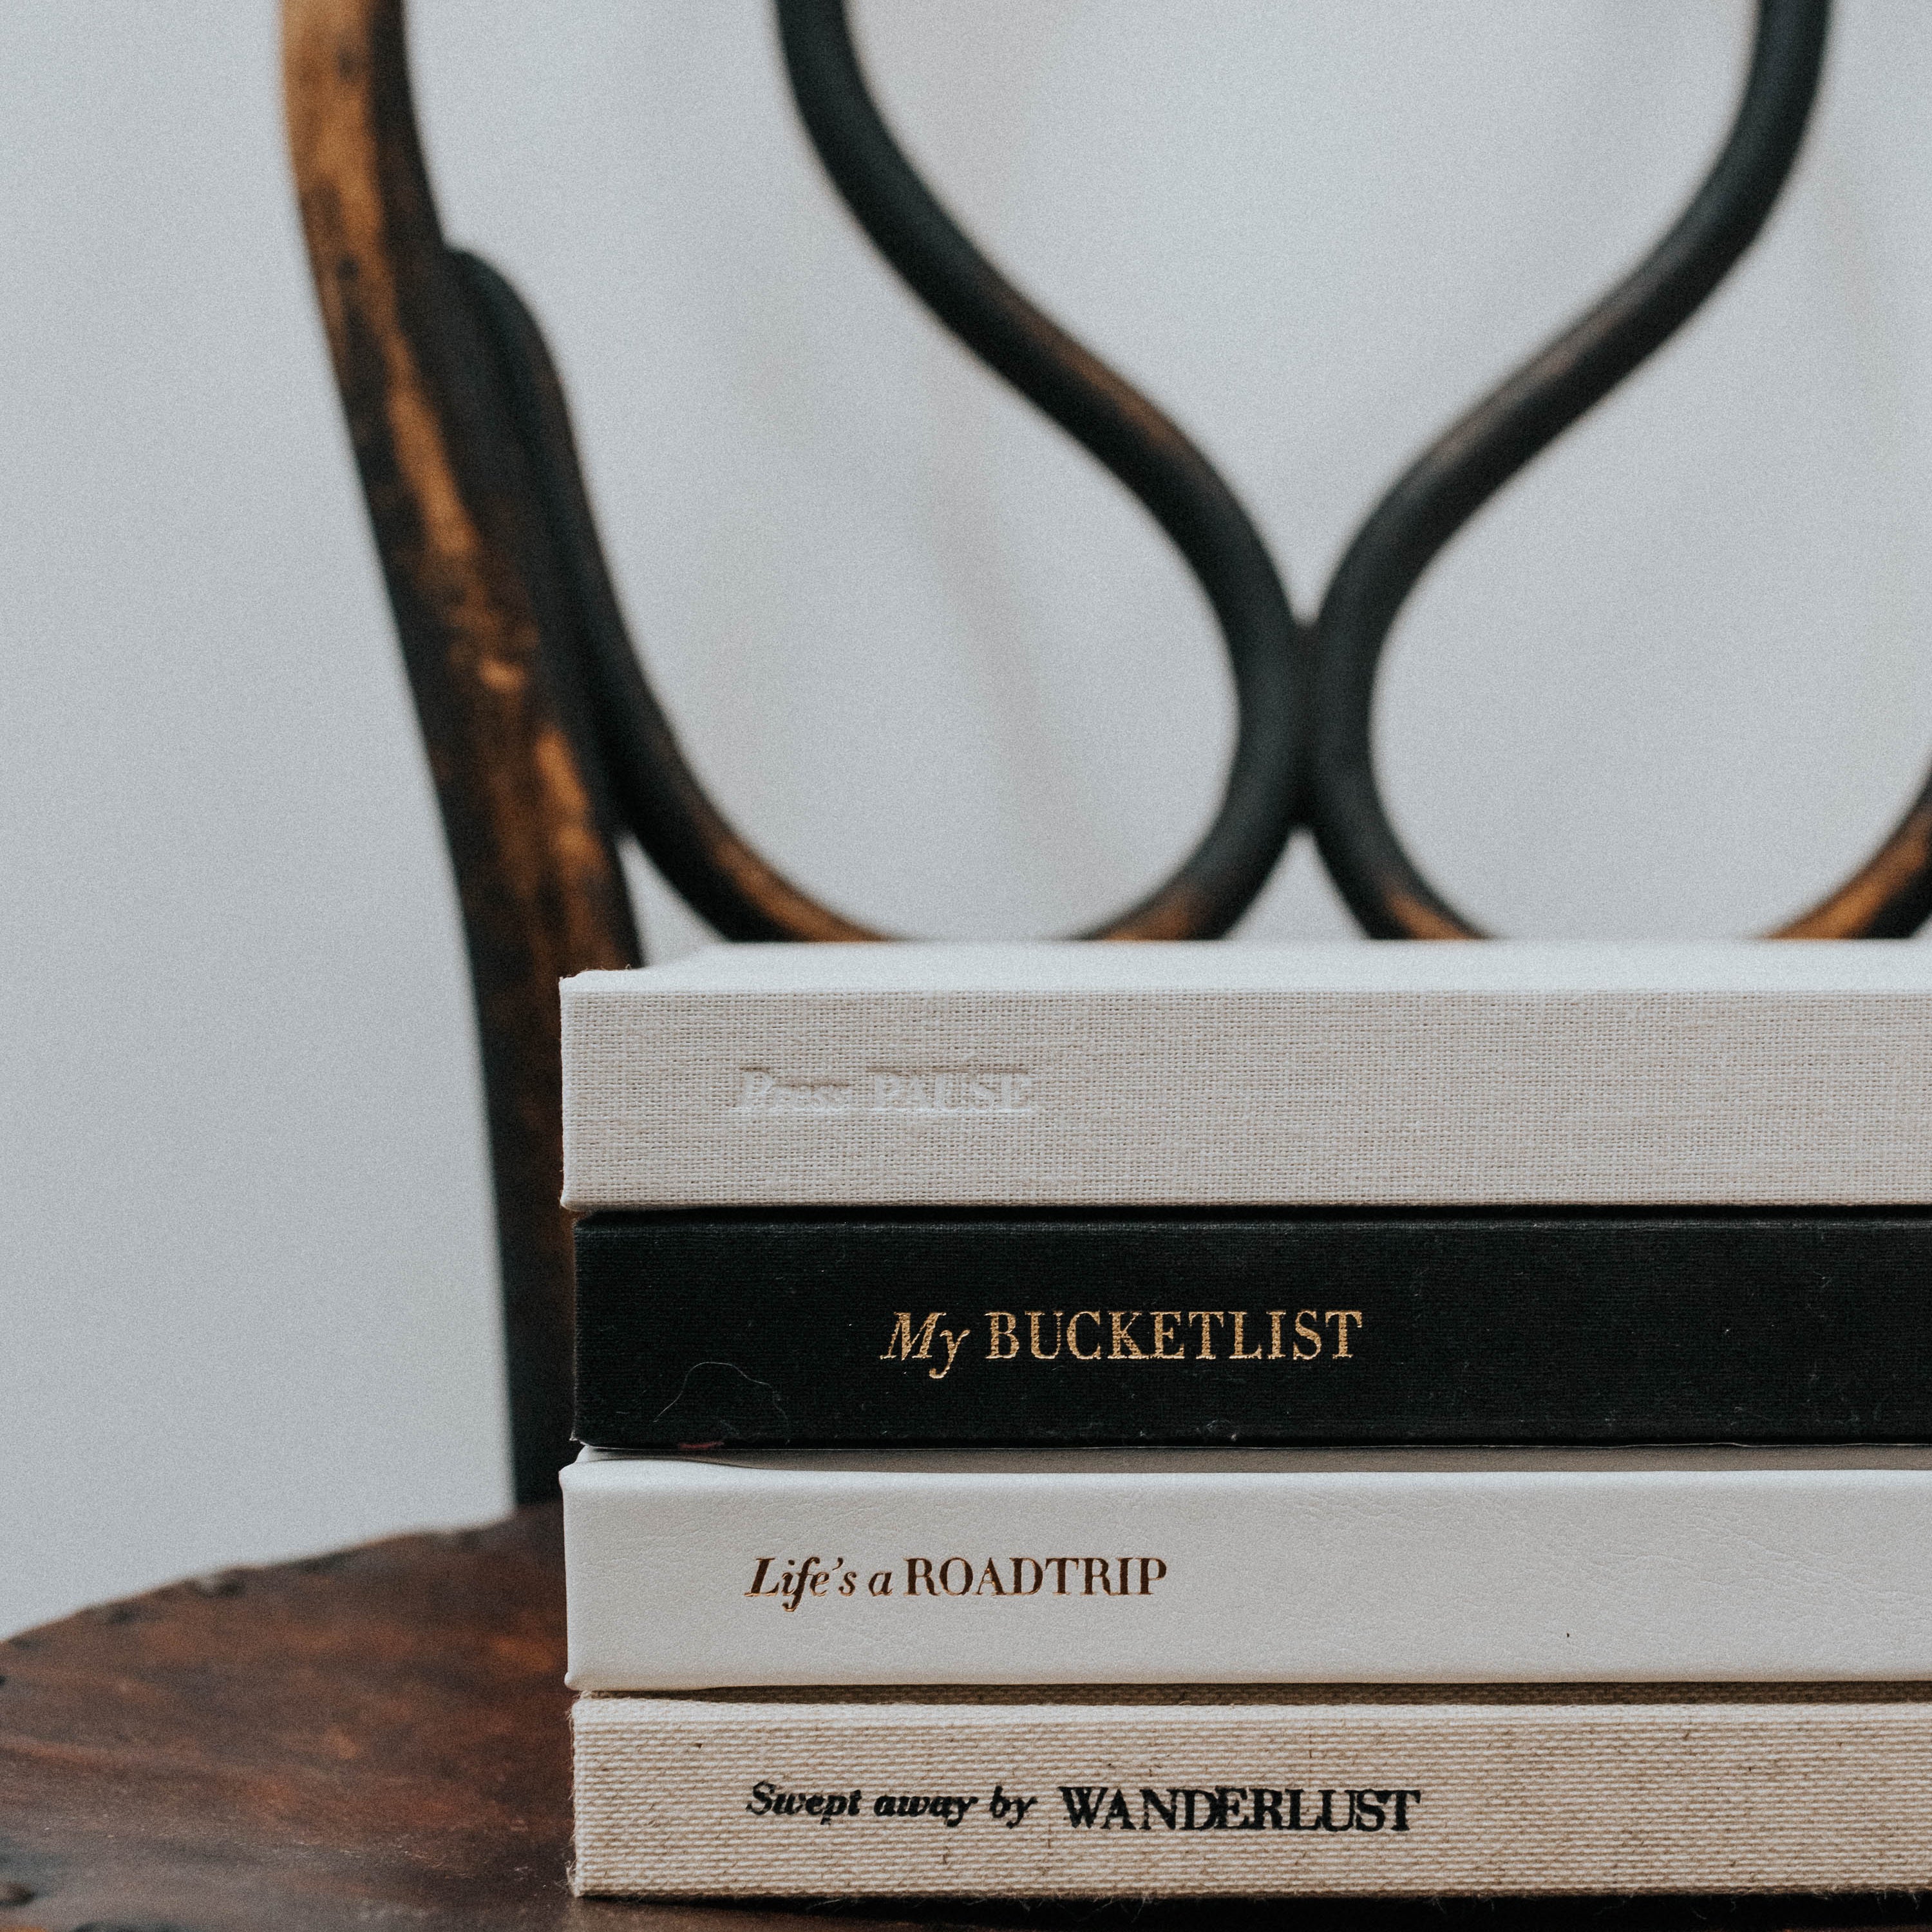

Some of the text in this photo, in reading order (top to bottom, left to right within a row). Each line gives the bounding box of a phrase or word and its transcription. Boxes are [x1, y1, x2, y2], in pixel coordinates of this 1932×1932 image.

[866, 1066, 1034, 1113] PAUSE
[880, 1309, 1363, 1379] My BUCKETLIST
[744, 1556, 1168, 1612] Life's a ROADTRIP
[747, 1779, 1421, 1832] Swept away by WANDERLUST
